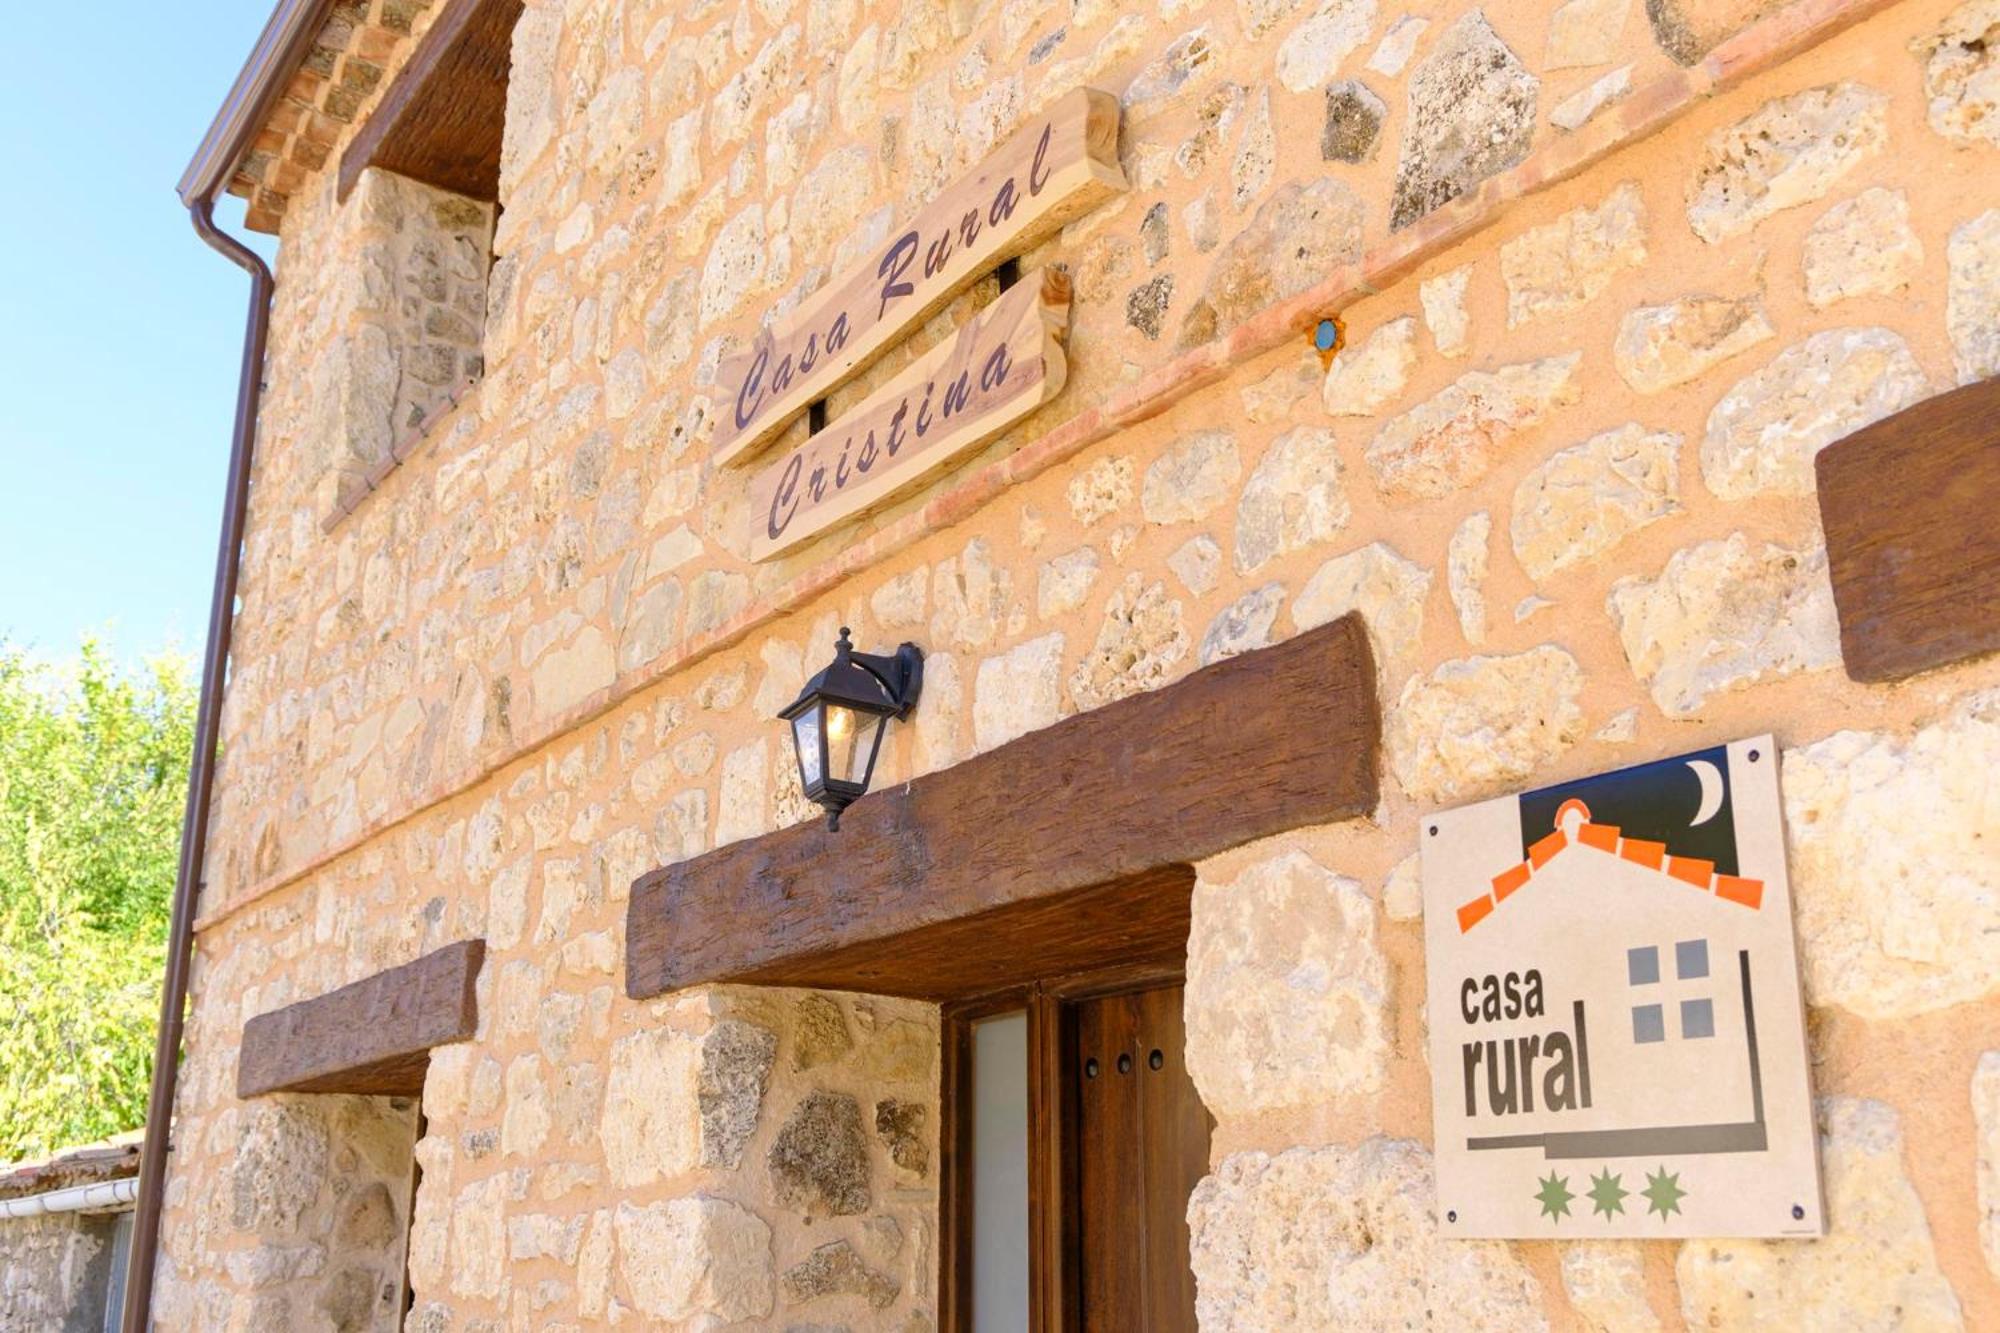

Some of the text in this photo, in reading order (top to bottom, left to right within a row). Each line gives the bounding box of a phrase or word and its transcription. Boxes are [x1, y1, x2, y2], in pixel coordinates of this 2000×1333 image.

[735, 123, 1052, 430] Casa Rural
[768, 342, 1012, 540] Cristina
[1462, 969, 1545, 1024] casa
[1462, 1001, 1592, 1117] rural
